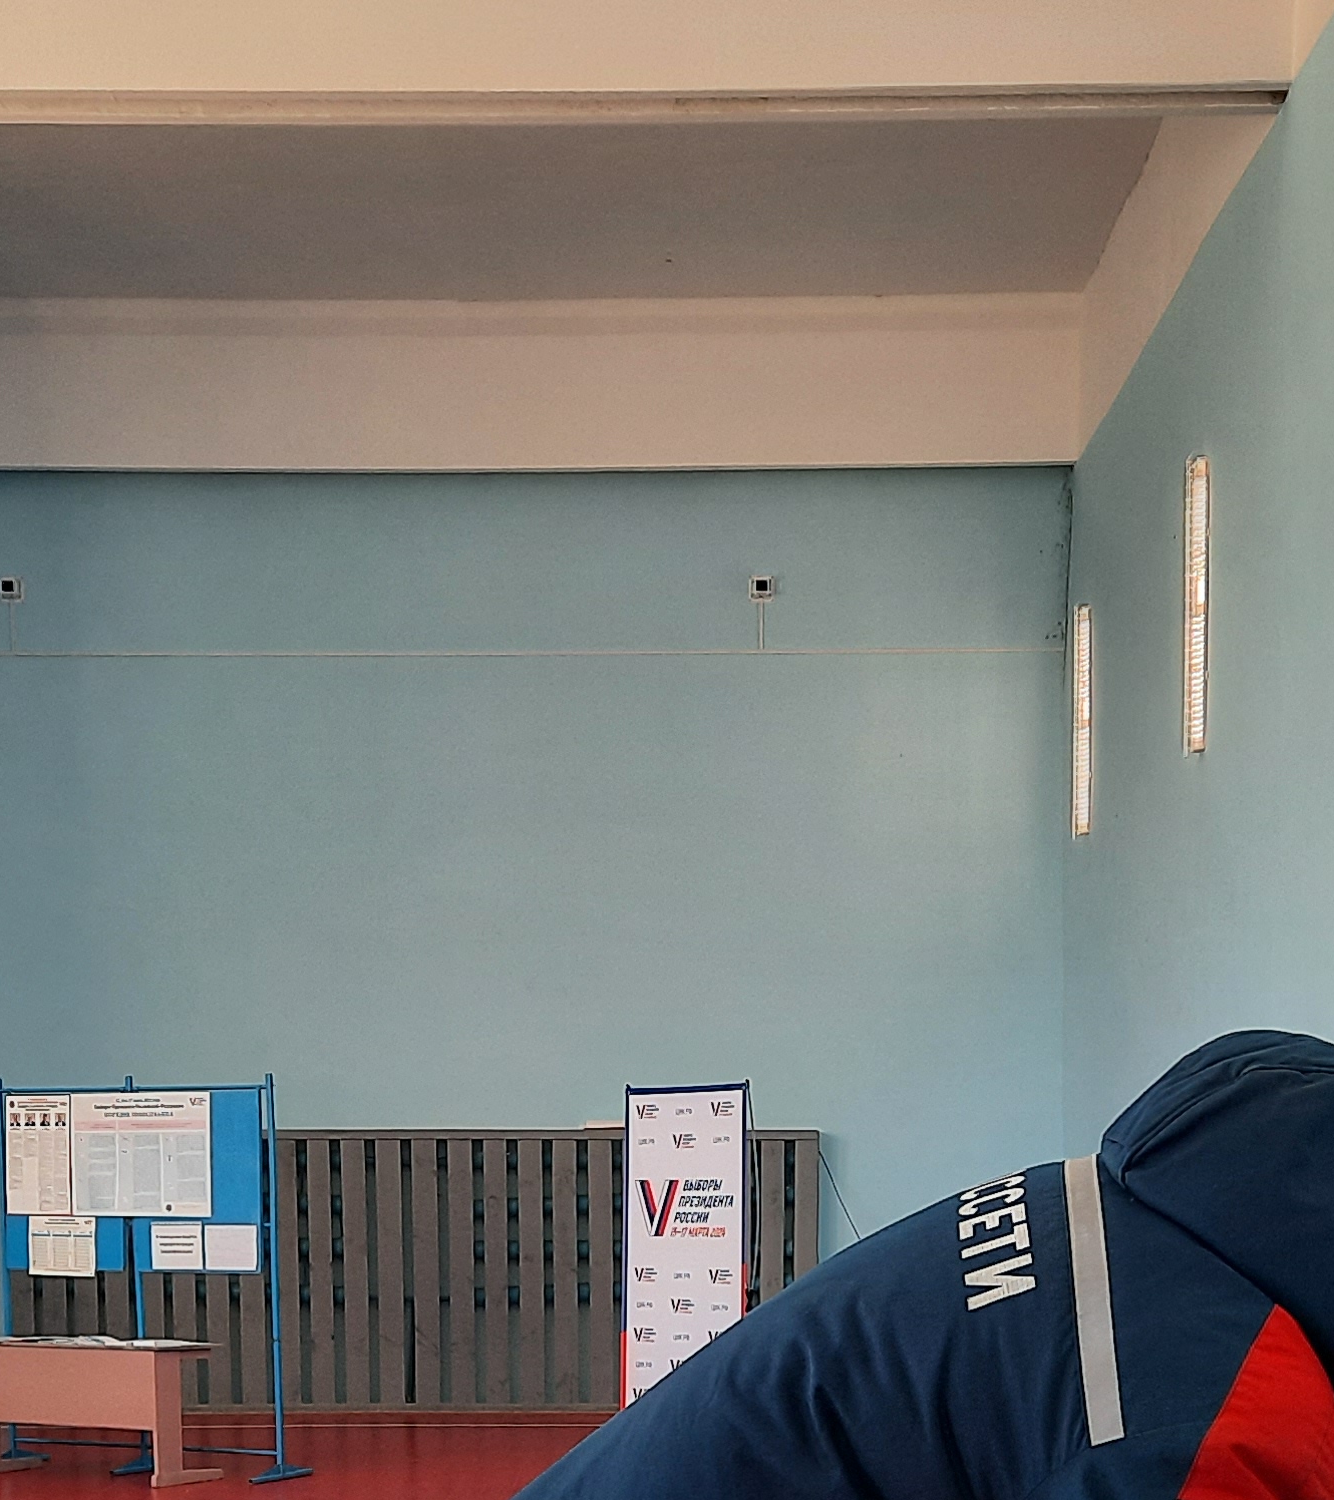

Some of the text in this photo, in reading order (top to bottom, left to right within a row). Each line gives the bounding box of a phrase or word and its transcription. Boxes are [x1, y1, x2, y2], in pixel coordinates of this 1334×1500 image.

[683, 1179, 723, 1192] ВЫБОРЫ
[678, 1195, 734, 1208] ПРЕЗИДЕНТА
[674, 1211, 709, 1223] РОССИИ
[958, 1170, 1036, 1312] ССЕТИ
